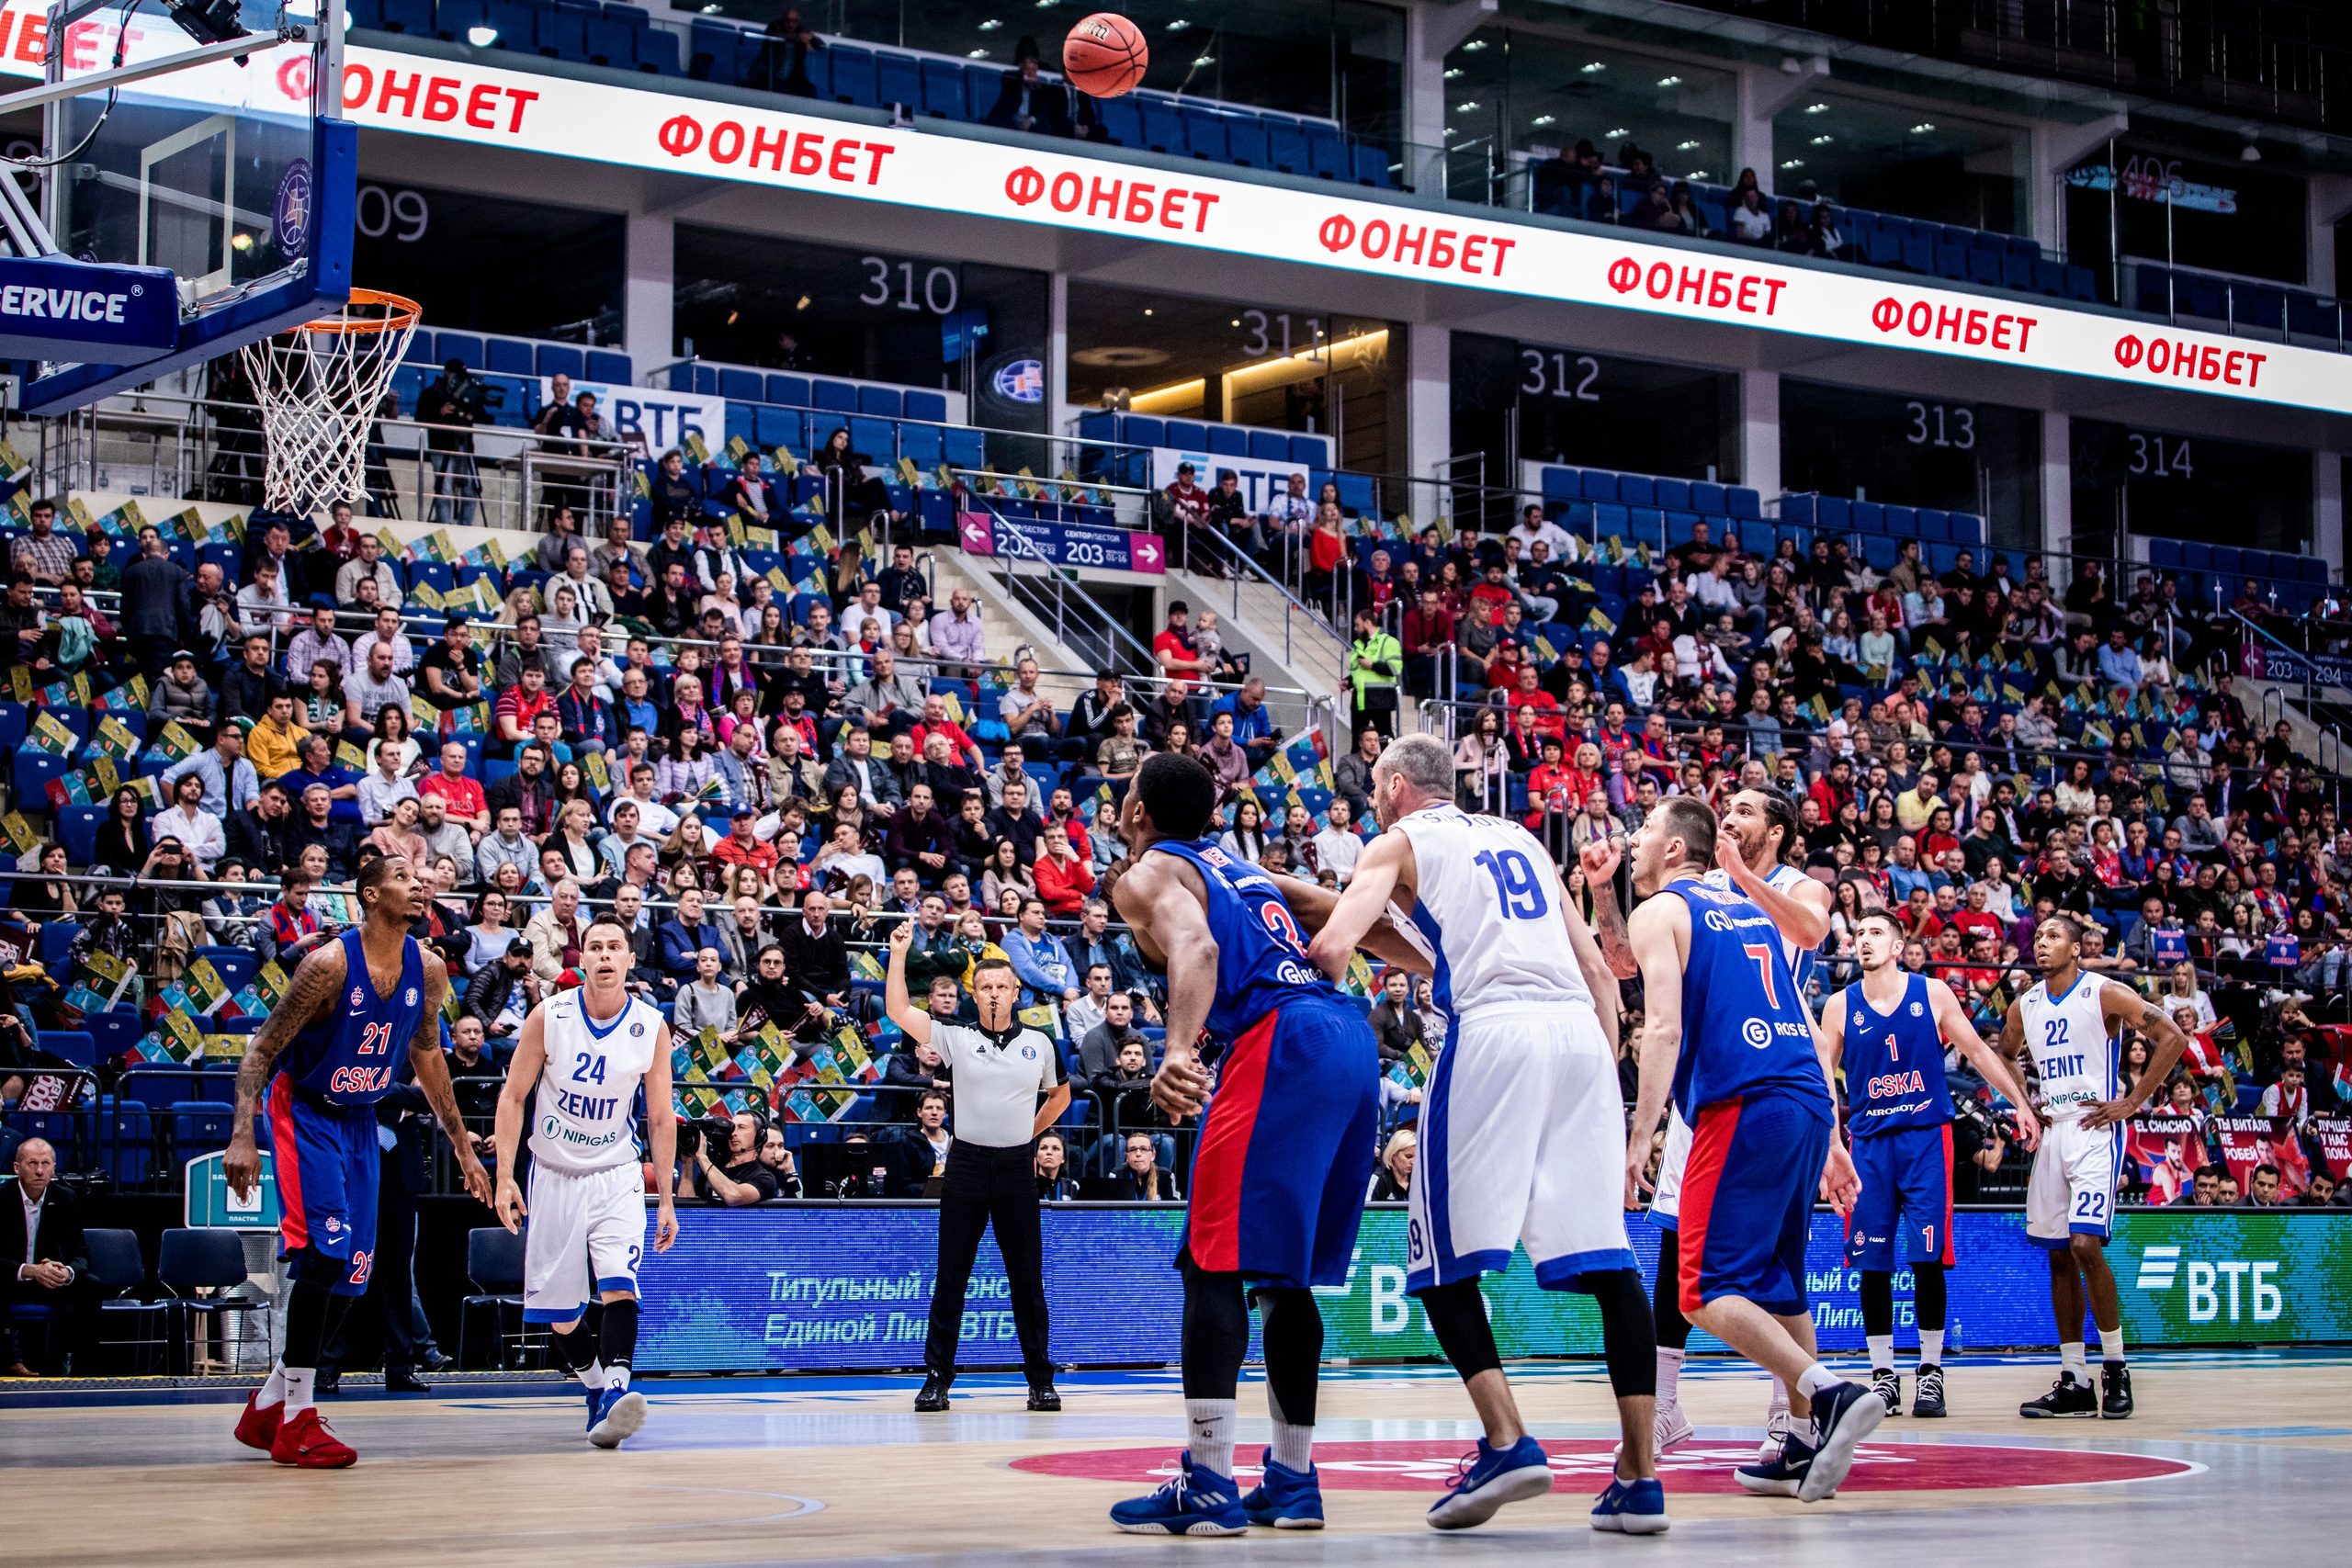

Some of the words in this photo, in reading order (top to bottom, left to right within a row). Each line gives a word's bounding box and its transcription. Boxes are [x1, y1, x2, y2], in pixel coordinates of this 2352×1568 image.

[659, 115, 895, 186] ФОНБЕТ
[2121, 154, 2186, 198] 406
[1005, 166, 1220, 233] ФОНБЕТ
[1319, 214, 1516, 276] ФОНБЕТ
[860, 257, 957, 314] 310
[1608, 256, 1787, 316] ФОНБЕТ
[0, 286, 128, 323] ERVICE
[1242, 310, 1325, 363] 311
[1872, 297, 2038, 353] ФОНБЕТ
[1521, 349, 1600, 401] 312
[2115, 334, 2266, 388] ФОНБЕТ
[615, 399, 706, 448] ВТБ
[1906, 401, 1974, 449] 313
[2128, 434, 2194, 479] 314
[996, 534, 1035, 557] 202
[1065, 529, 1120, 543] СЕКТОР/SECTOR
[1066, 541, 1104, 565] 203
[1105, 553, 1127, 563] 01-16
[2267, 660, 2293, 679] 203
[2314, 664, 2341, 682] 204
[1473, 849, 1548, 919] 19
[1743, 943, 1781, 1010] 7
[357, 1021, 392, 1055] 21
[1885, 1033, 1899, 1062] 1
[2045, 1018, 2069, 1046] 22
[331, 1066, 392, 1093] CSKA
[571, 1052, 606, 1085] 24
[1868, 1070, 1925, 1100] CSKA
[2040, 1055, 2084, 1082] ZENIT
[557, 1088, 619, 1121] ZENIT
[2051, 1091, 2097, 1105] NIPIGAS
[562, 1128, 616, 1146] NIPIGAS
[2134, 1119, 2148, 1134] EL
[2148, 1119, 2192, 1134] CHACHO
[2215, 1118, 2231, 1131] ТЫ
[2232, 1119, 2271, 1133] ВИТАЛЯ
[2220, 1132, 2234, 1146] НЕ
[2317, 1119, 2352, 1134] ЛУЧШЕ
[2321, 1134, 2327, 1146] У
[2328, 1134, 2348, 1146] НАС
[2224, 1145, 2259, 1161] РОБЕЙ
[2324, 1146, 2351, 1160] ПОКА
[2076, 1190, 2105, 1219] 22
[1922, 1225, 1933, 1252] 1
[765, 1270, 921, 1309] Титульный
[2188, 1261, 2282, 1322] ВТБ
[763, 1313, 876, 1348] Единой
[958, 1311, 1016, 1340] ВТБ
